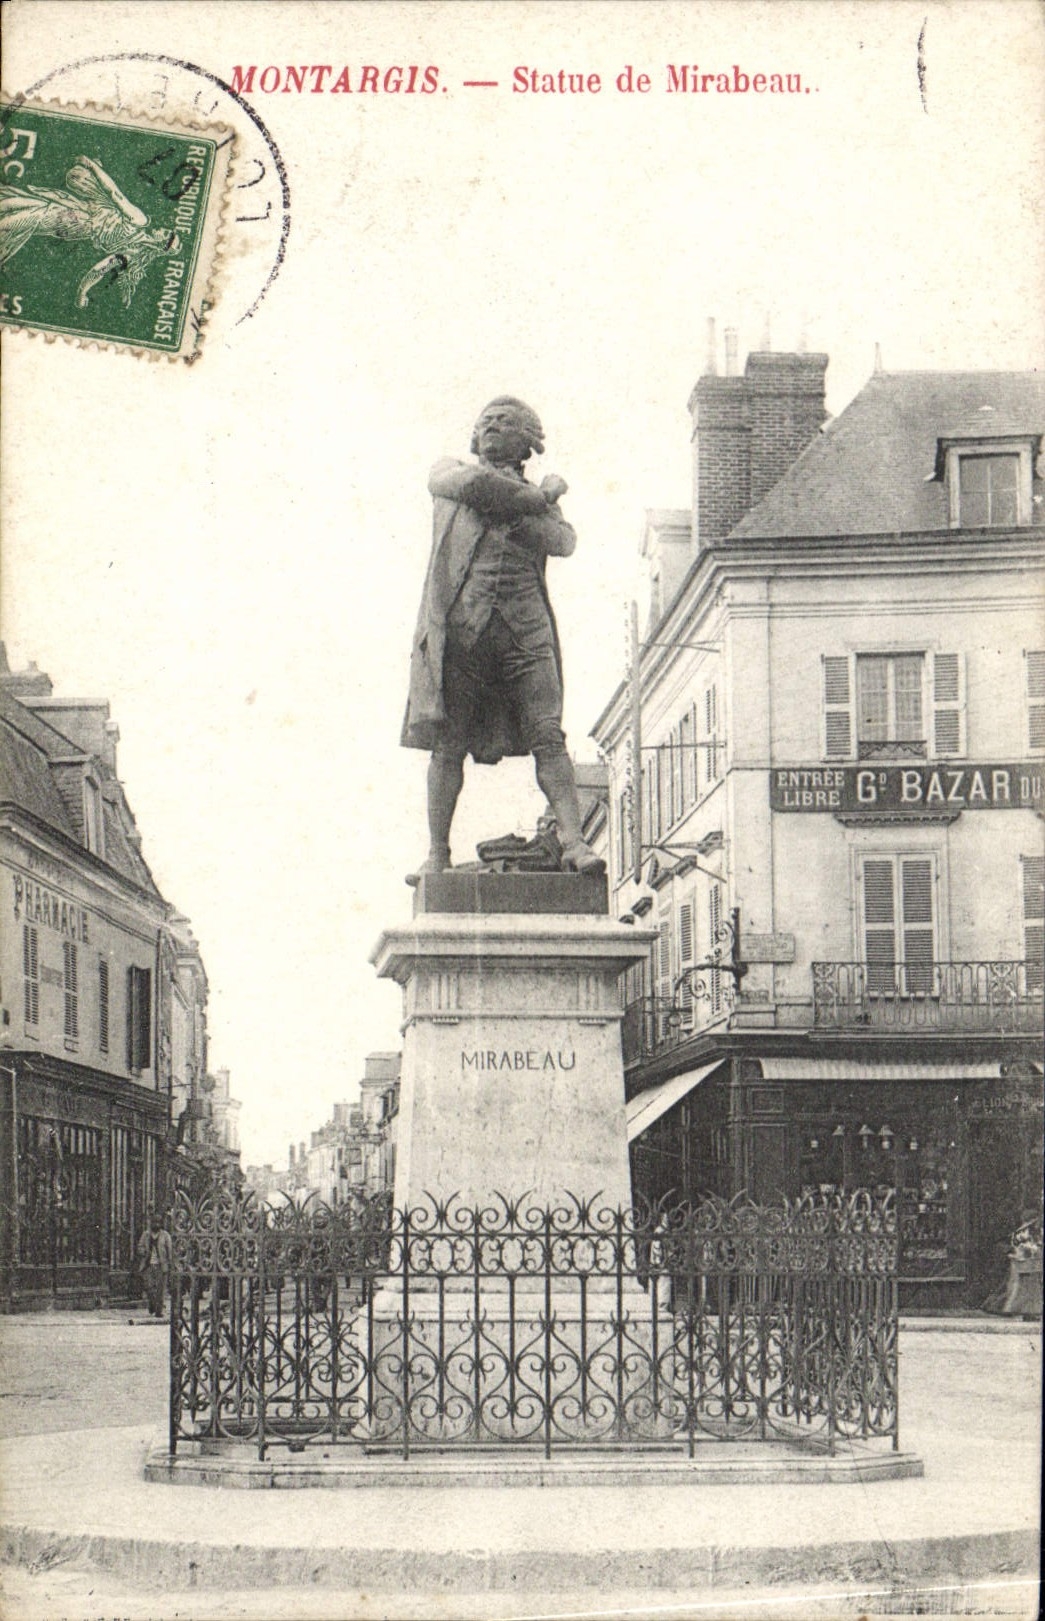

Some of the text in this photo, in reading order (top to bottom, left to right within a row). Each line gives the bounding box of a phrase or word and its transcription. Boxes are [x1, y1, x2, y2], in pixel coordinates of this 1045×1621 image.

[153, 259, 185, 342] FRANÇAISE
[777, 769, 845, 788] ENTRÉE
[901, 770, 1010, 802] BAZAR
[784, 790, 840, 807] LIBRE
[13, 874, 91, 945] PHARMACIE
[461, 1050, 576, 1070] MIRABEAU
